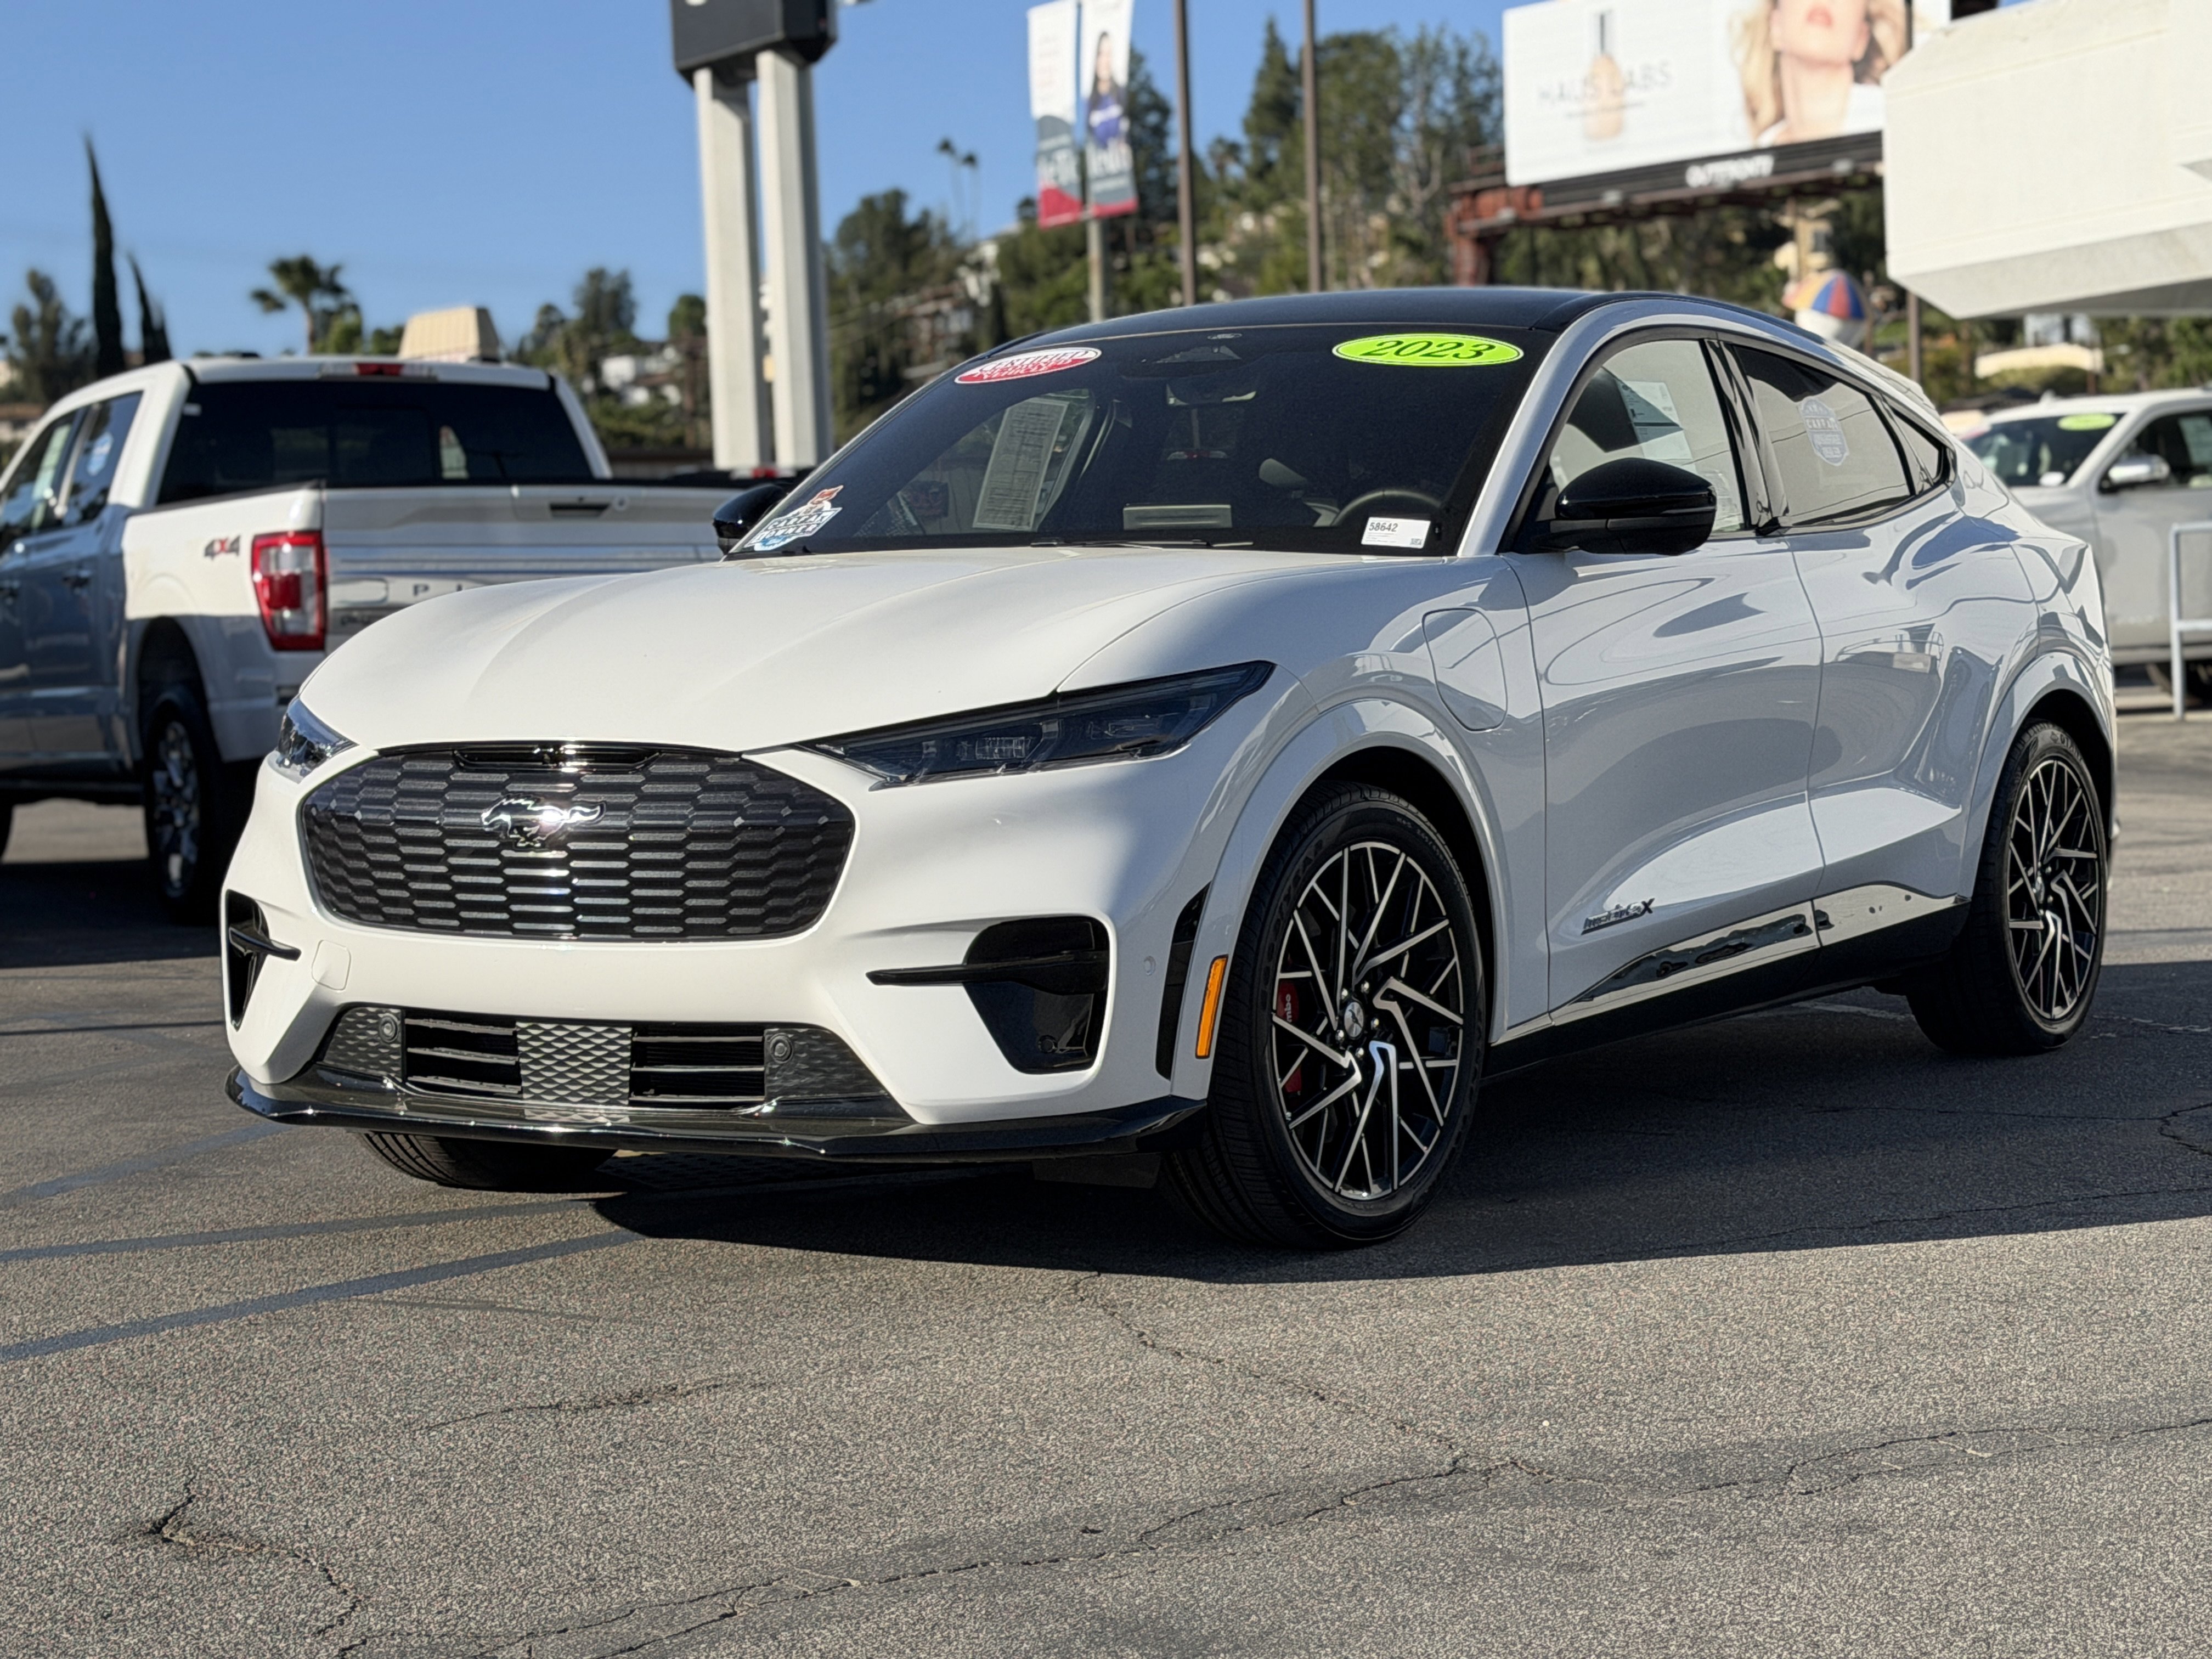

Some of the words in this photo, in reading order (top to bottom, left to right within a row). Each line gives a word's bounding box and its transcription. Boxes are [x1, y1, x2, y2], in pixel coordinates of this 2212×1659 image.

[1359, 340, 1496, 359] 2023
[1369, 522, 1398, 532] 58642
[1284, 994, 1293, 1023] mbo
